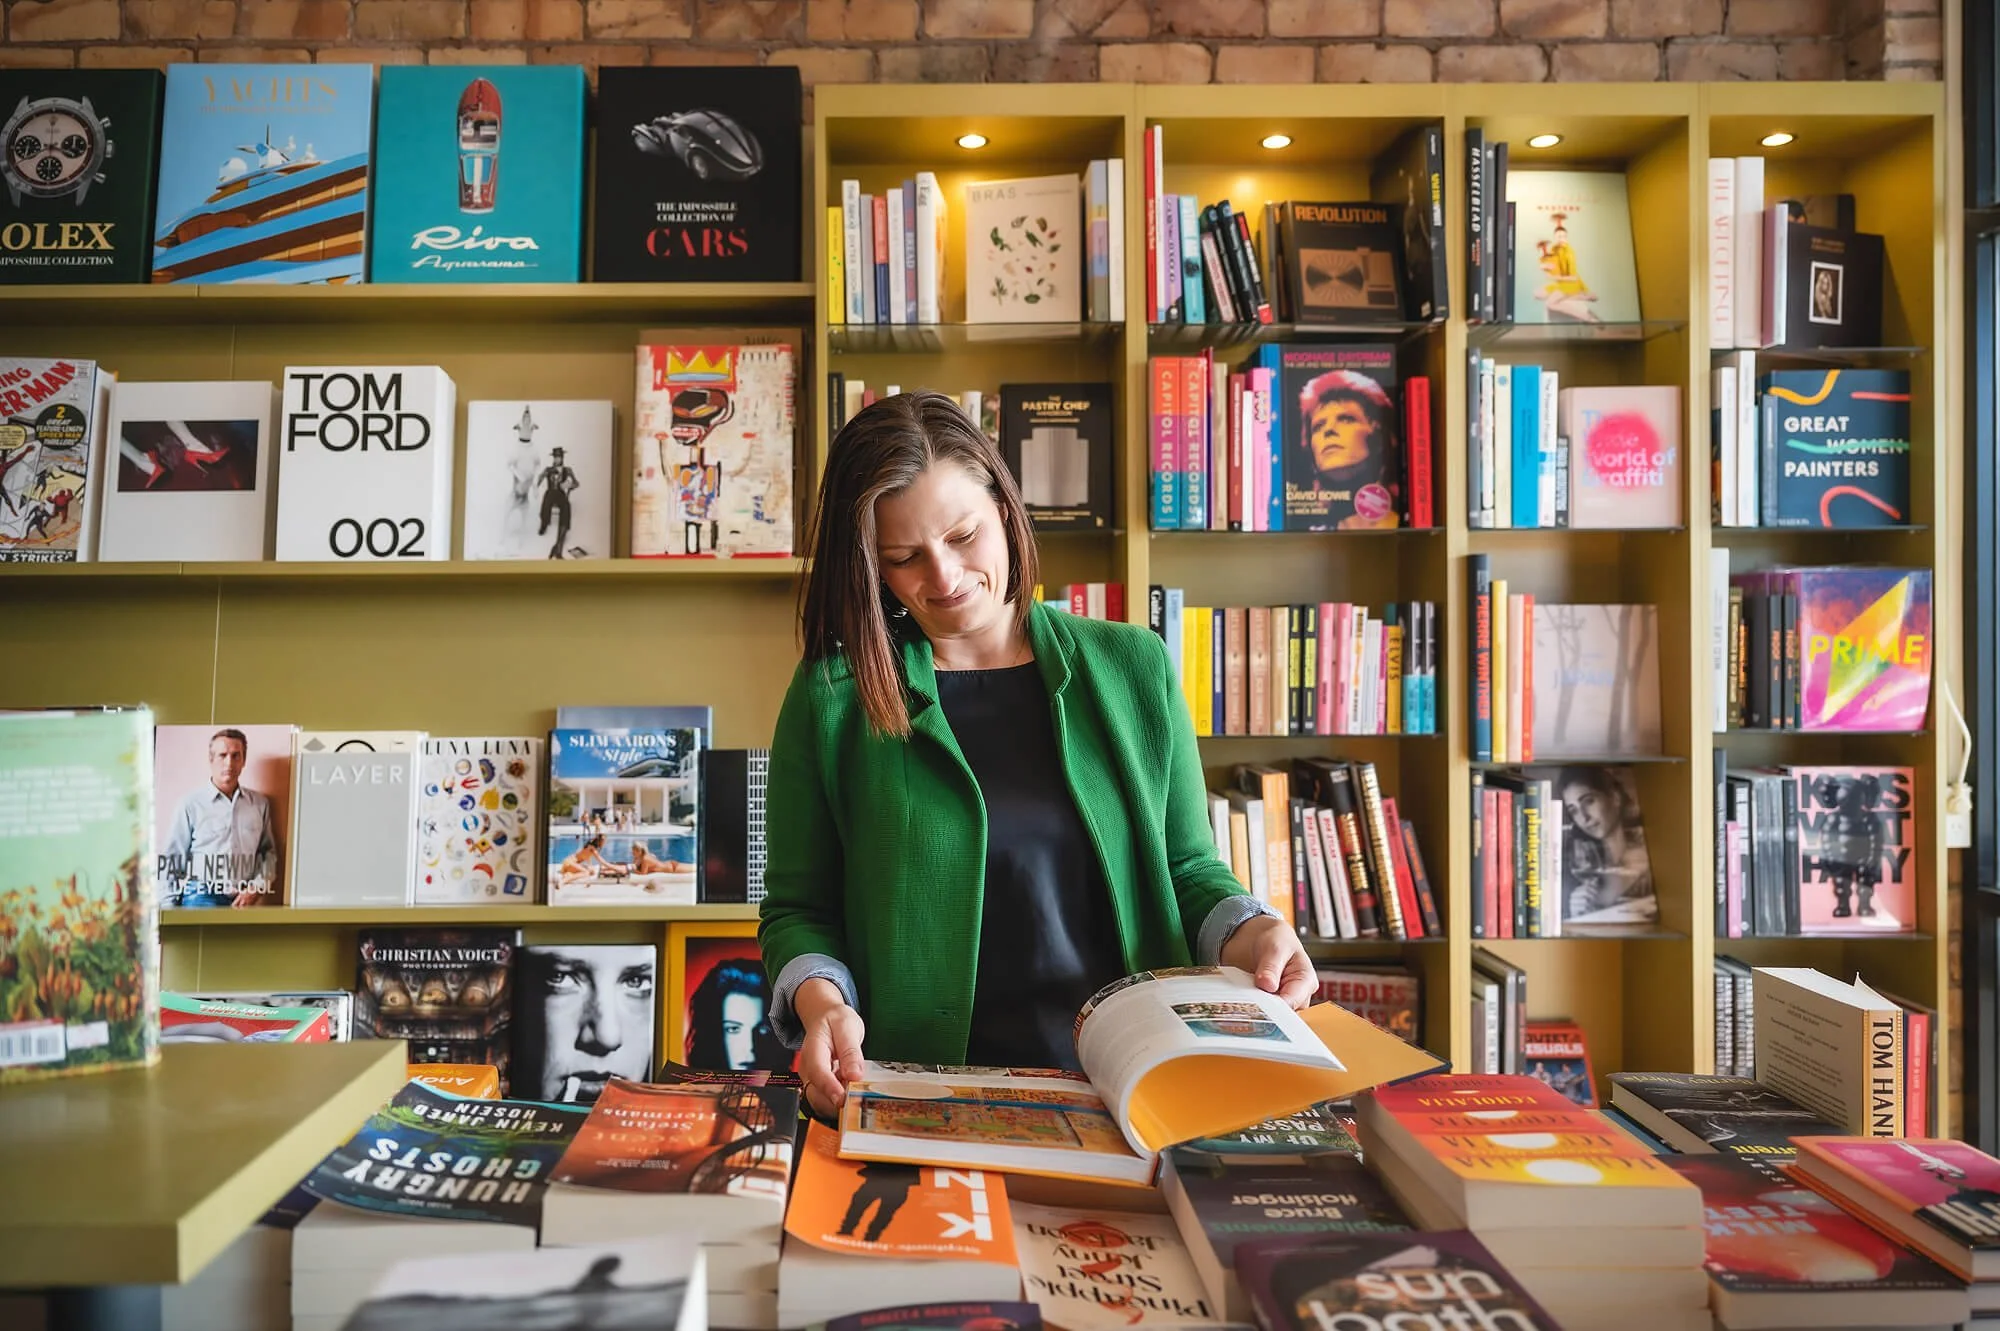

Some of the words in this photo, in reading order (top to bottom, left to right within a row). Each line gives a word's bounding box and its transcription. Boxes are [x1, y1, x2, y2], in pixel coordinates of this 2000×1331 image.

[972, 186, 1018, 203] BRAS
[1471, 147, 1481, 233] HASSELBLAD
[656, 202, 676, 212] THE
[678, 202, 738, 212] IMPOSSIBLE
[656, 212, 720, 222] COLLECTION
[1295, 206, 1388, 223] REVOLUTION
[0, 222, 116, 250] OLEX
[411, 225, 540, 251] Riva
[646, 228, 749, 257] CARS
[52, 254, 114, 266] COLLECTION
[289, 372, 403, 412] TOM
[55, 405, 65, 419] 2
[1021, 401, 1061, 411] PASTRY
[1062, 401, 1091, 411] CHEF
[1161, 370, 1173, 438] CAPITOL
[1187, 371, 1200, 439] CAPITOL
[287, 413, 431, 453] FORD
[1784, 416, 1850, 433] GREAT
[1651, 446, 1676, 467] of
[1826, 438, 1904, 455] WOMEN
[1161, 442, 1173, 515] RECORDS
[1784, 460, 1880, 477] PAINTERS
[1286, 490, 1317, 501] DAVID
[1318, 490, 1351, 501] BOWIE
[329, 518, 426, 559] 002
[1150, 589, 1161, 627] Guitar
[1477, 595, 1489, 648] PIERRE
[1389, 637, 1400, 681] ELVIS
[1808, 635, 1925, 665] PRIME
[425, 740, 471, 756] LUNA
[484, 740, 532, 756] LUNA
[569, 733, 608, 748] SLIM
[612, 733, 678, 748] AARONS
[602, 746, 644, 763] Style
[309, 764, 404, 786] LAYER
[157, 853, 198, 881] PAUL
[1523, 808, 1543, 908] photography
[238, 880, 276, 895] COOL
[373, 948, 452, 963] CHRISTIAN
[457, 948, 501, 962] VOIGT
[1872, 1018, 1895, 1069] TOM
[454, 1103, 537, 1119] HOSEIN
[1417, 1096, 1539, 1107] ECHOLALIA
[413, 1104, 486, 1127] JARED
[495, 1117, 563, 1133] KEVIN
[620, 1119, 694, 1131] Stefan
[368, 1137, 542, 1179] GHOSTS
[343, 1160, 532, 1204] HUNGRY
[1230, 1192, 1359, 1207] Holsinger
[1263, 1206, 1343, 1220] Bruce
[1026, 1223, 1167, 1252] Jackson
[1702, 1220, 1818, 1238] MILK
[1052, 1243, 1153, 1271] Jenny
[1056, 1264, 1163, 1293] Street
[1355, 1268, 1503, 1301] sun
[1029, 1274, 1211, 1319] Pineapple
